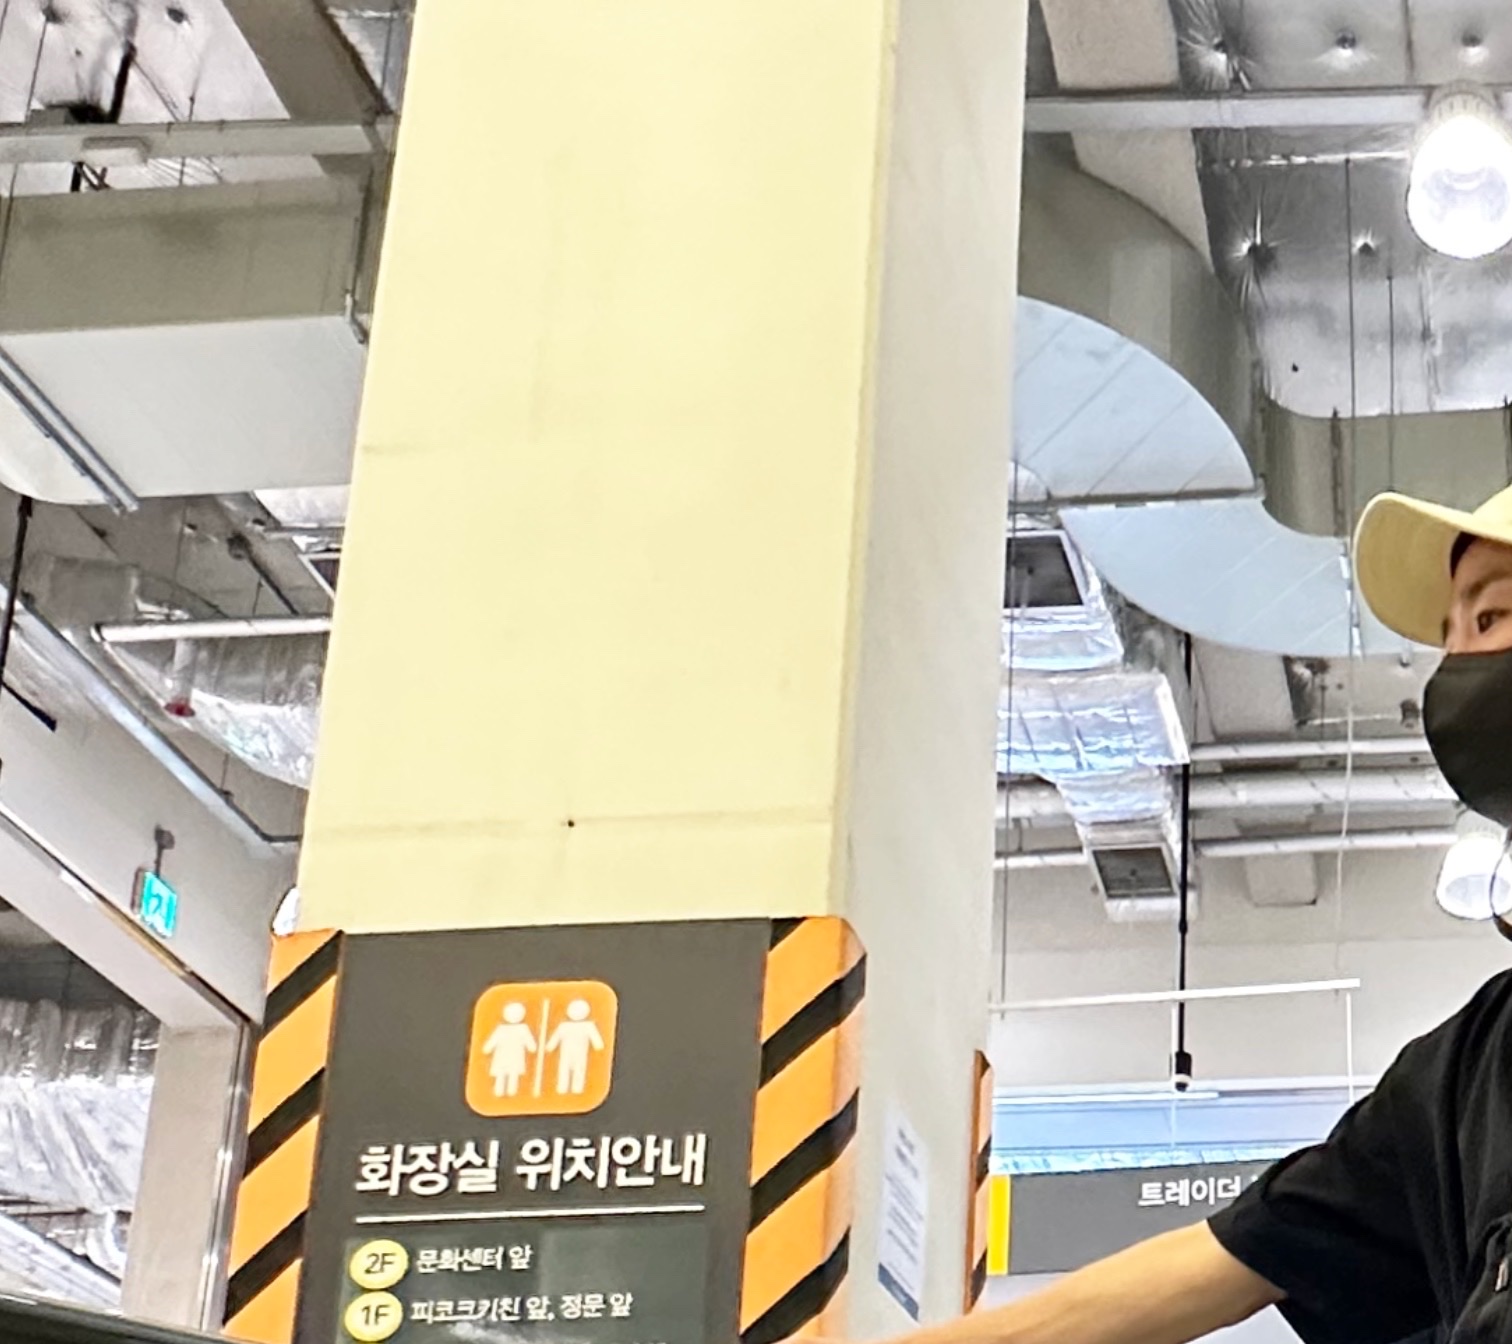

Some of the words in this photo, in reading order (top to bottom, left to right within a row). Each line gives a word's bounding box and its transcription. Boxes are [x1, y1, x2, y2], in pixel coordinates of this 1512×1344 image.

[354, 1139, 500, 1197] 화장실
[515, 1133, 707, 1191] 위치안내
[1138, 1175, 1259, 1206] 트레이더
[364, 1253, 397, 1275] 2F
[416, 1246, 505, 1274] 문화센터
[508, 1245, 534, 1271] 앞
[361, 1304, 391, 1327] 1F
[410, 1296, 521, 1324] 피코크키친
[560, 1294, 606, 1319] 정문
[609, 1291, 634, 1317] 앞
